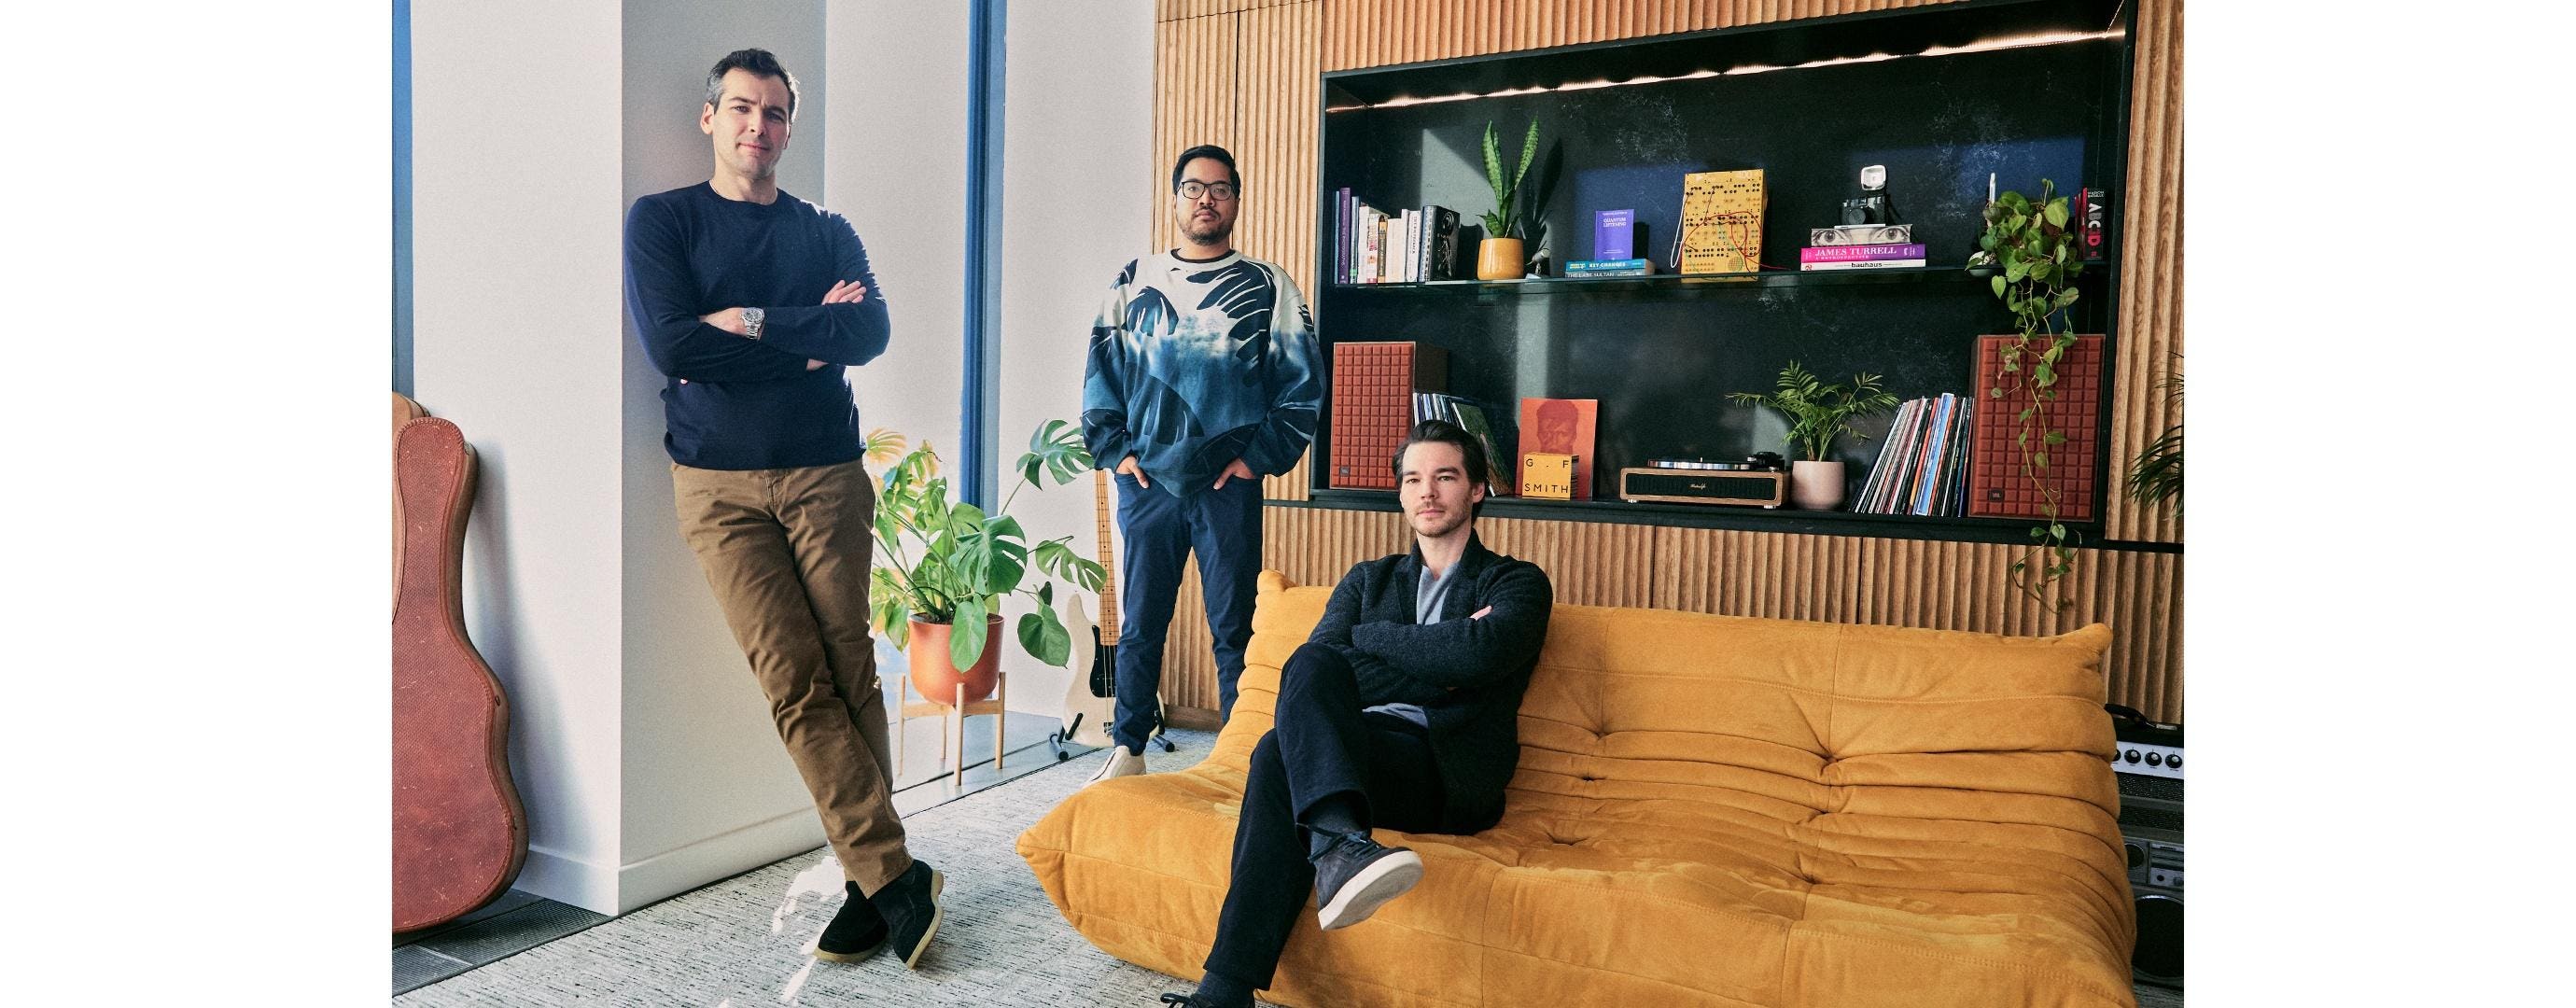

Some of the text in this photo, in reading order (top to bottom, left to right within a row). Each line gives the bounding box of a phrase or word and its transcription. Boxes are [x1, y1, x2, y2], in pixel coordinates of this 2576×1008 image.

[1814, 247, 1847, 257] JAMES
[1849, 246, 1897, 256] TURRELL
[1526, 458, 1533, 467] G
[1562, 460, 1569, 469] F
[1524, 483, 1569, 493] SMITH
